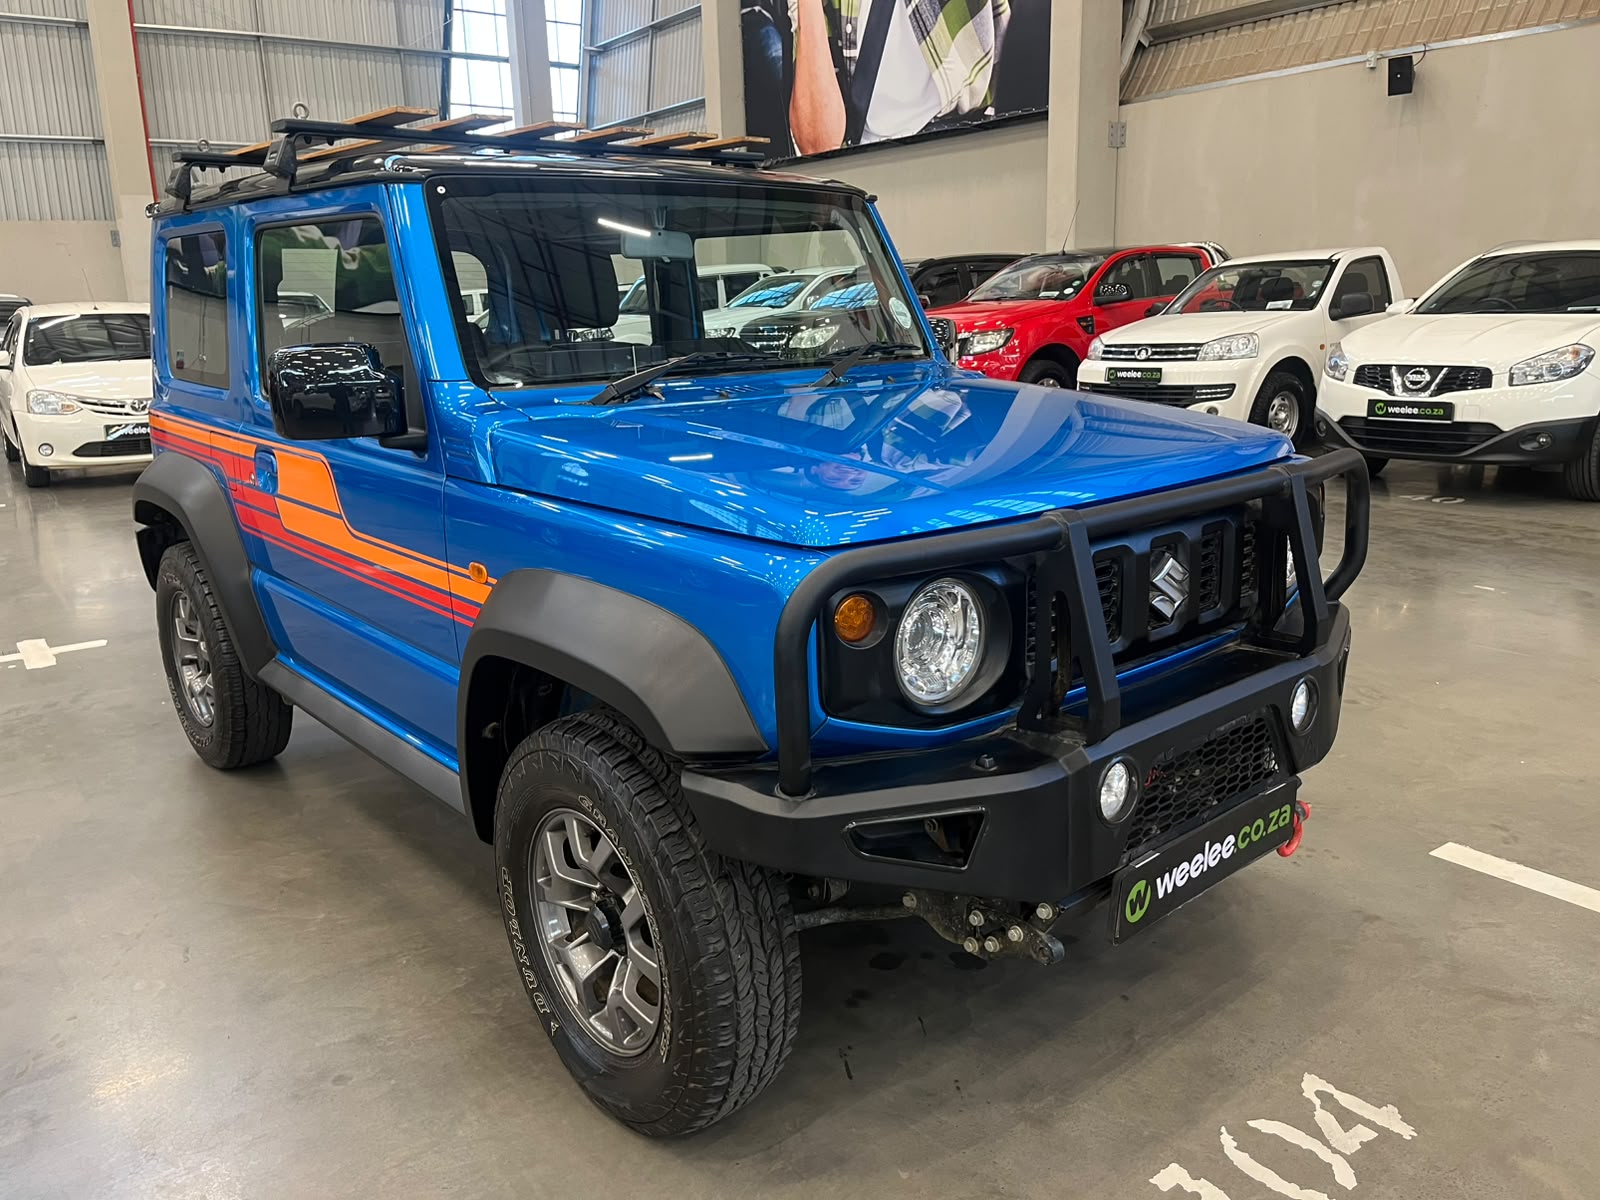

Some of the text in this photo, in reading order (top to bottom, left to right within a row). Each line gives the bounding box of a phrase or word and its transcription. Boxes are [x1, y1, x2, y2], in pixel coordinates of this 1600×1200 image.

[1387, 405, 1444, 415] weelee.co.za
[1156, 804, 1291, 899] weelee.co.za
[501, 866, 550, 1014] DUNLOP
